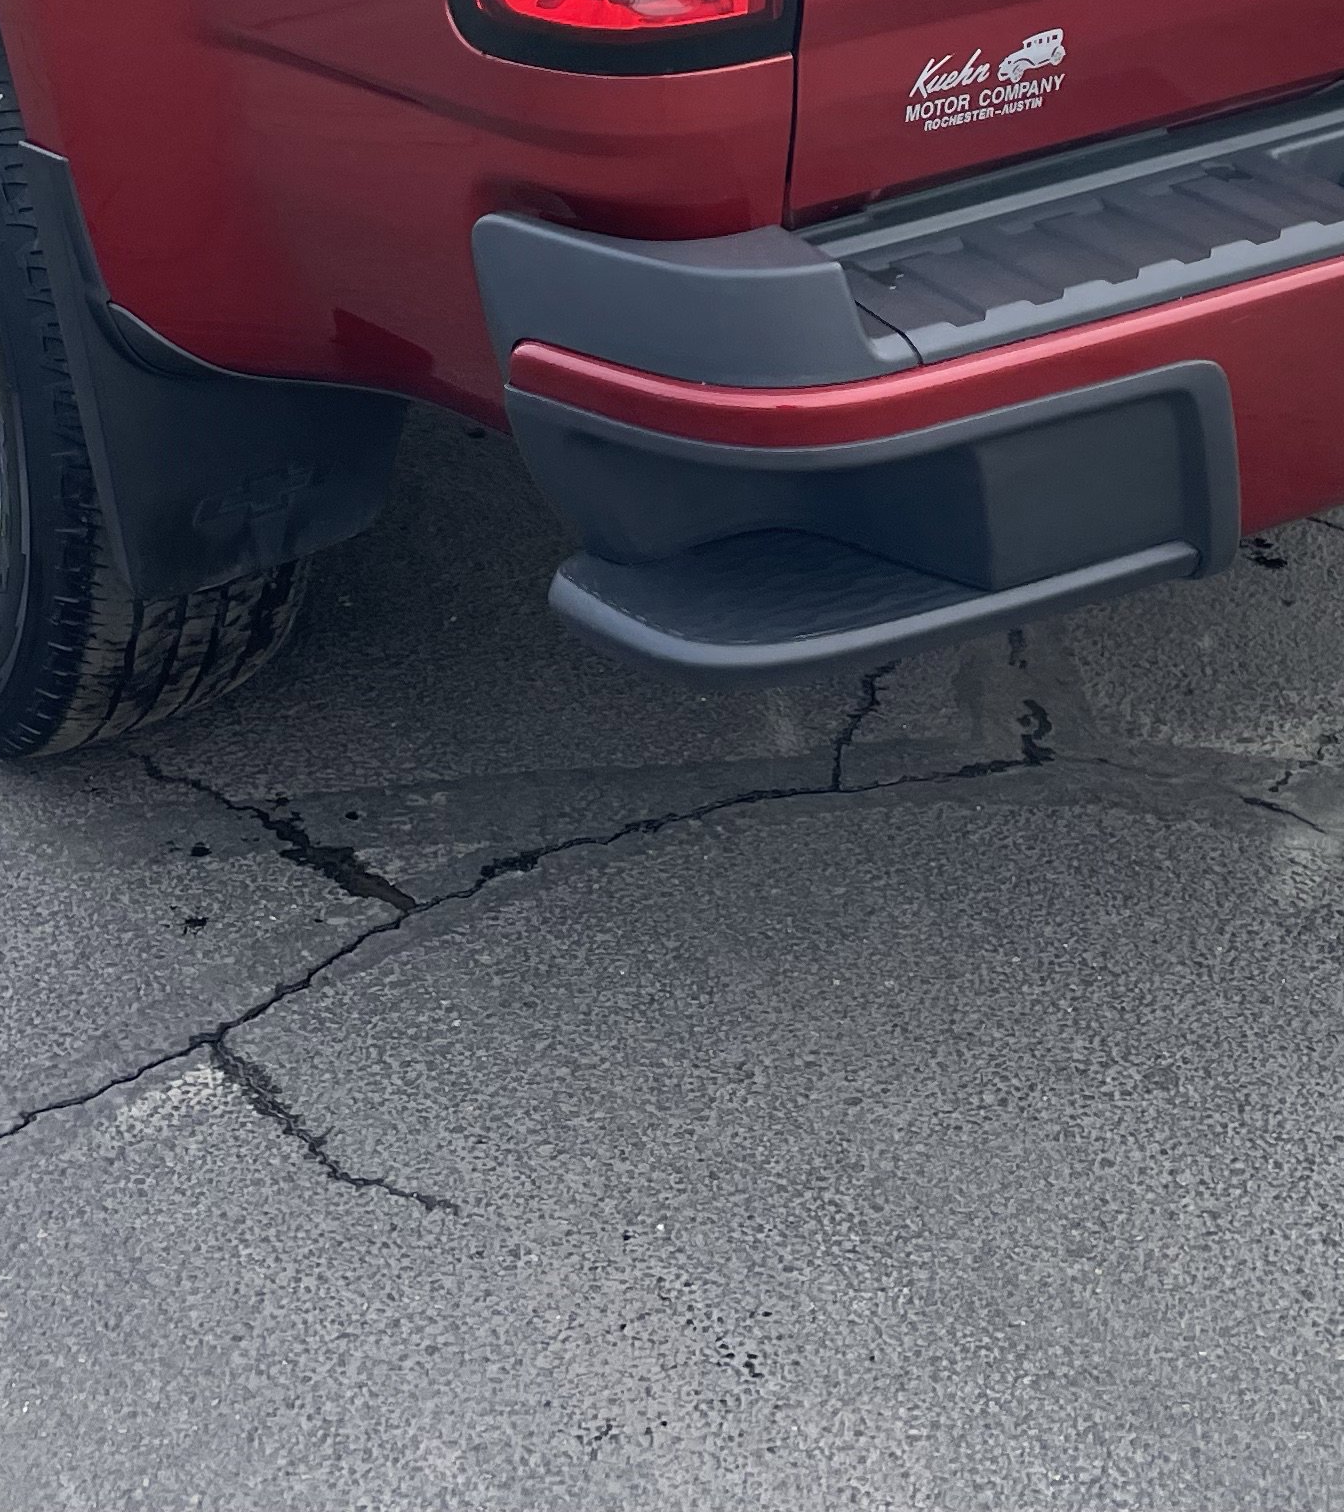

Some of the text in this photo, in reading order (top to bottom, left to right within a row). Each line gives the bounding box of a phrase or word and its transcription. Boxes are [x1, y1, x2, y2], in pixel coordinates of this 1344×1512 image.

[905, 73, 1066, 123] MOTOR COMPANY
[909, 48, 991, 99] Kuehn
